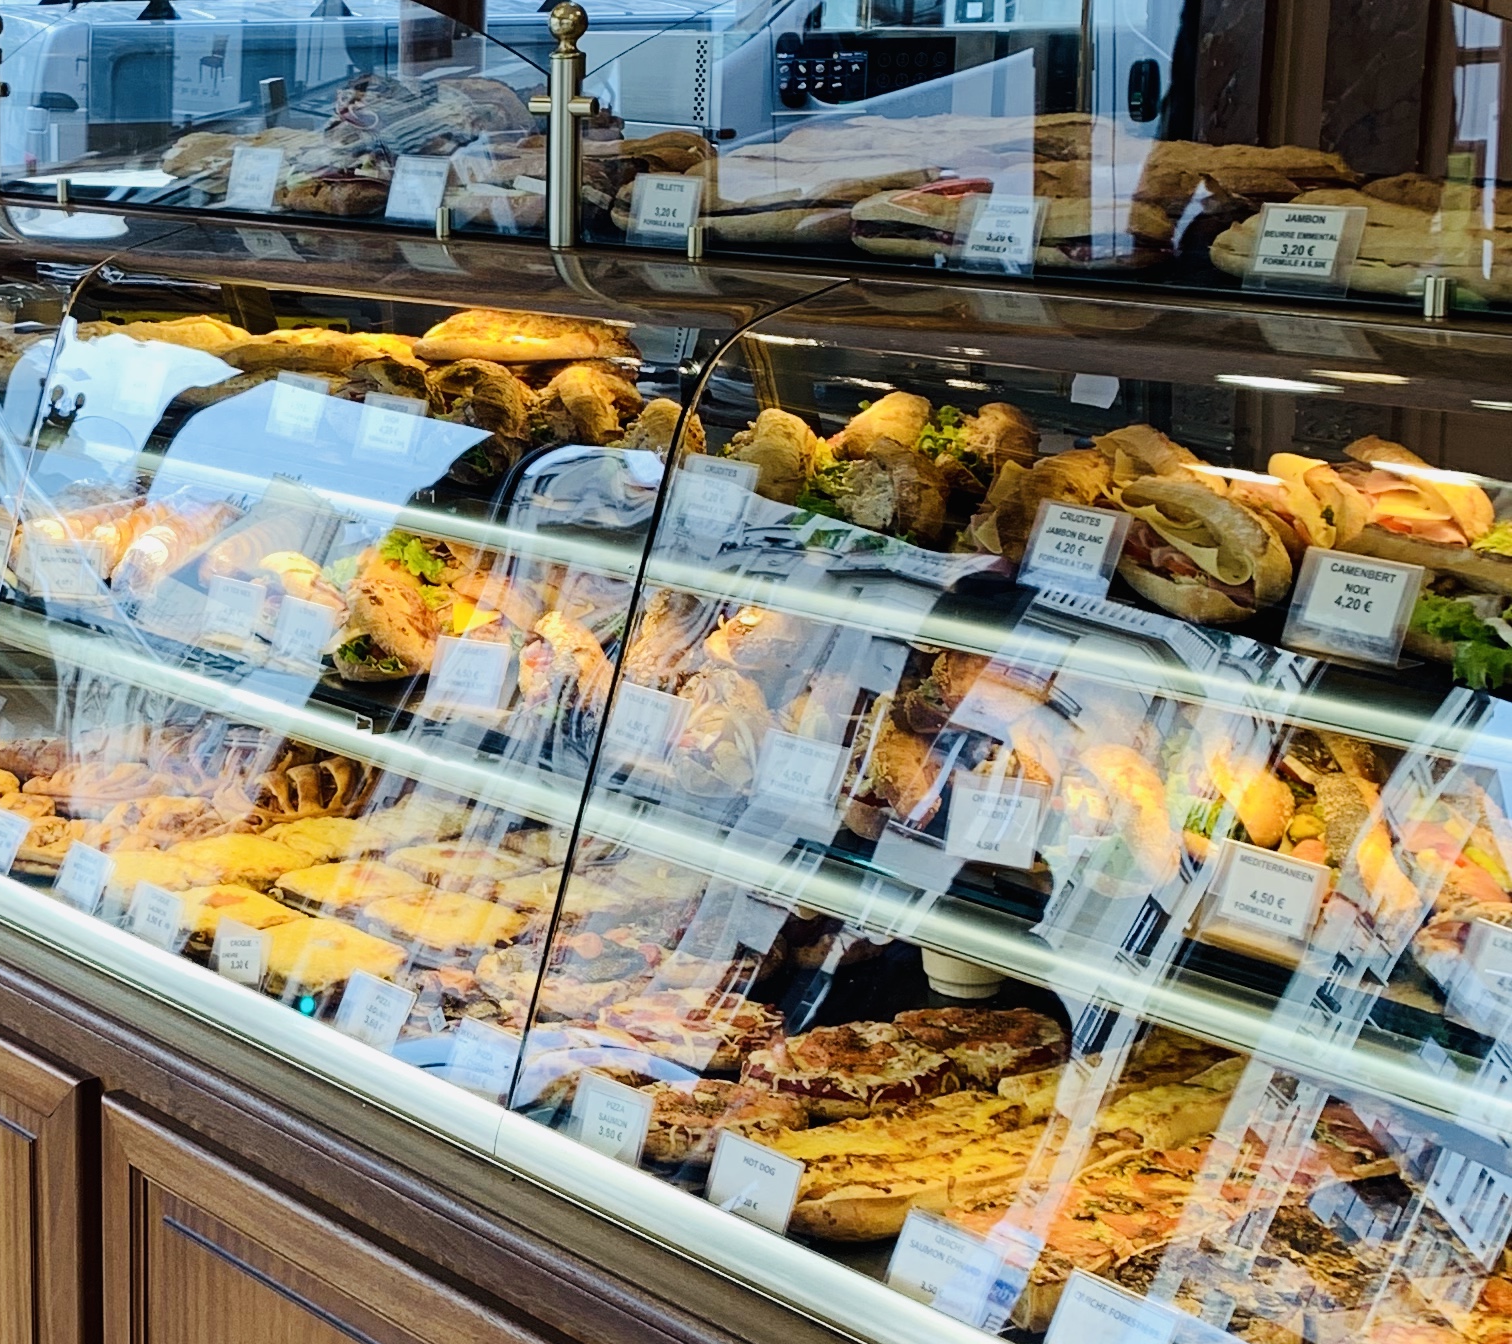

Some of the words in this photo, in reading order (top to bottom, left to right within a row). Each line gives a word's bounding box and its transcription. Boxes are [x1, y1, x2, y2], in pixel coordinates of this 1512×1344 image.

[655, 182, 685, 192] RILLETTE
[1285, 213, 1326, 224] JAMBON
[1280, 243, 1305, 257] 3,20
[1308, 245, 1316, 256] €
[1059, 511, 1101, 527] CRUDITES
[1046, 526, 1076, 539] JAMBON
[1077, 533, 1104, 545] BLANC
[1055, 541, 1076, 554] 4,20
[1077, 545, 1085, 557] €
[1330, 562, 1397, 584] CAMENBERT
[1345, 583, 1371, 596] NOIX
[1334, 595, 1361, 610] 4,20
[1363, 601, 1373, 613] €
[1239, 854, 1314, 882] MEDITERRANEEN
[1249, 890, 1275, 906] 4,50
[1277, 897, 1286, 910] €
[1234, 901, 1272, 920] FORMULE
[230, 939, 252, 947] CROQUE
[605, 1100, 625, 1114] PIZZA
[598, 1112, 628, 1129] SAUMON
[743, 1156, 760, 1170] HOT
[759, 1163, 776, 1177] DOG
[909, 1239, 944, 1262] SAUMON
[934, 1234, 966, 1254] QUICHE
[1074, 1291, 1108, 1313] QUICHE
